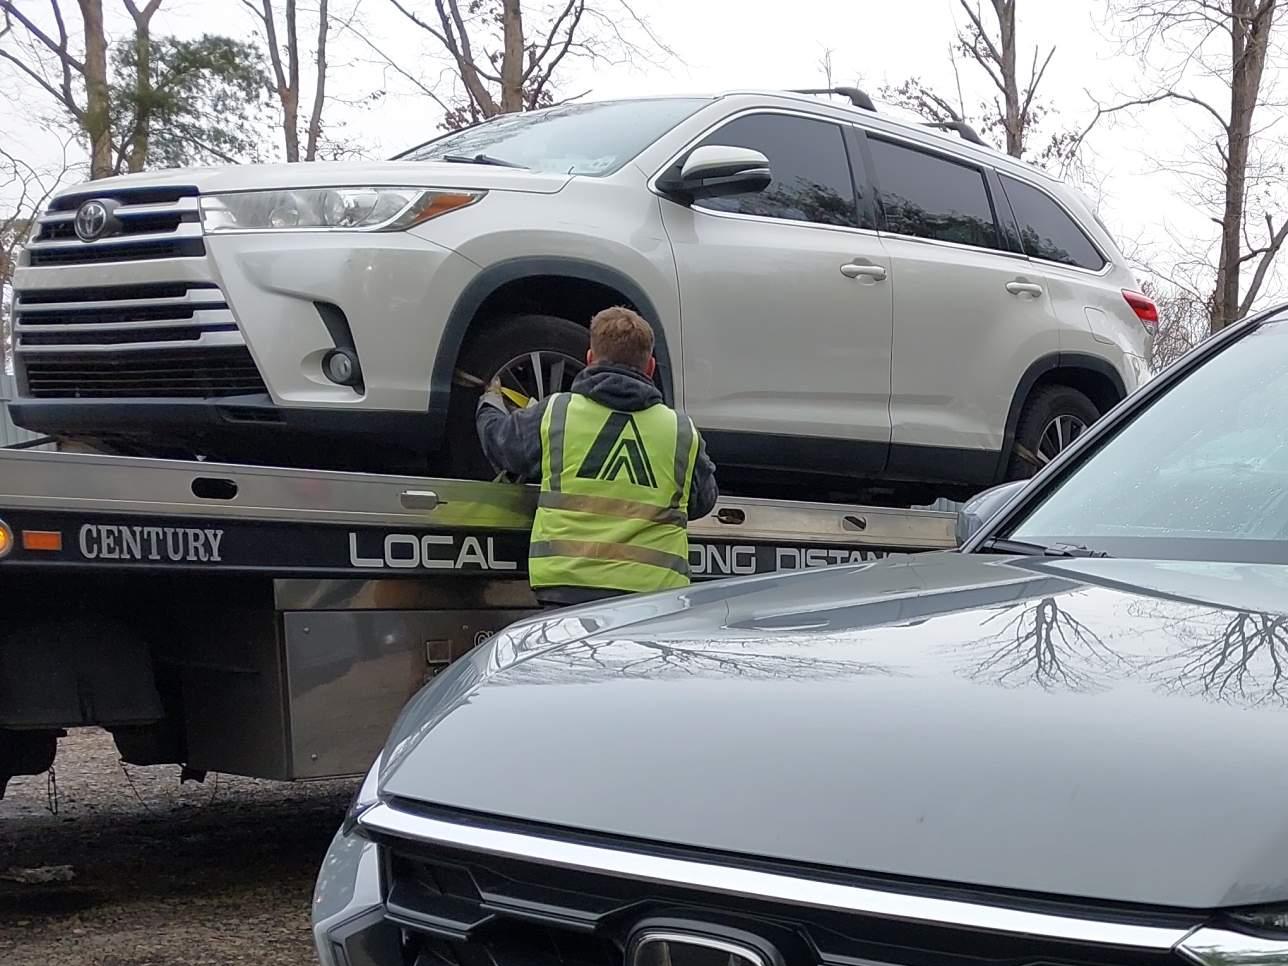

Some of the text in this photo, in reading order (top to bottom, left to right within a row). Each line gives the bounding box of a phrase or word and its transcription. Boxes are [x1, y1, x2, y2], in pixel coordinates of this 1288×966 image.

[79, 524, 224, 562] CENTURY
[349, 532, 517, 570] LOCAL
[688, 544, 756, 574] ONG
